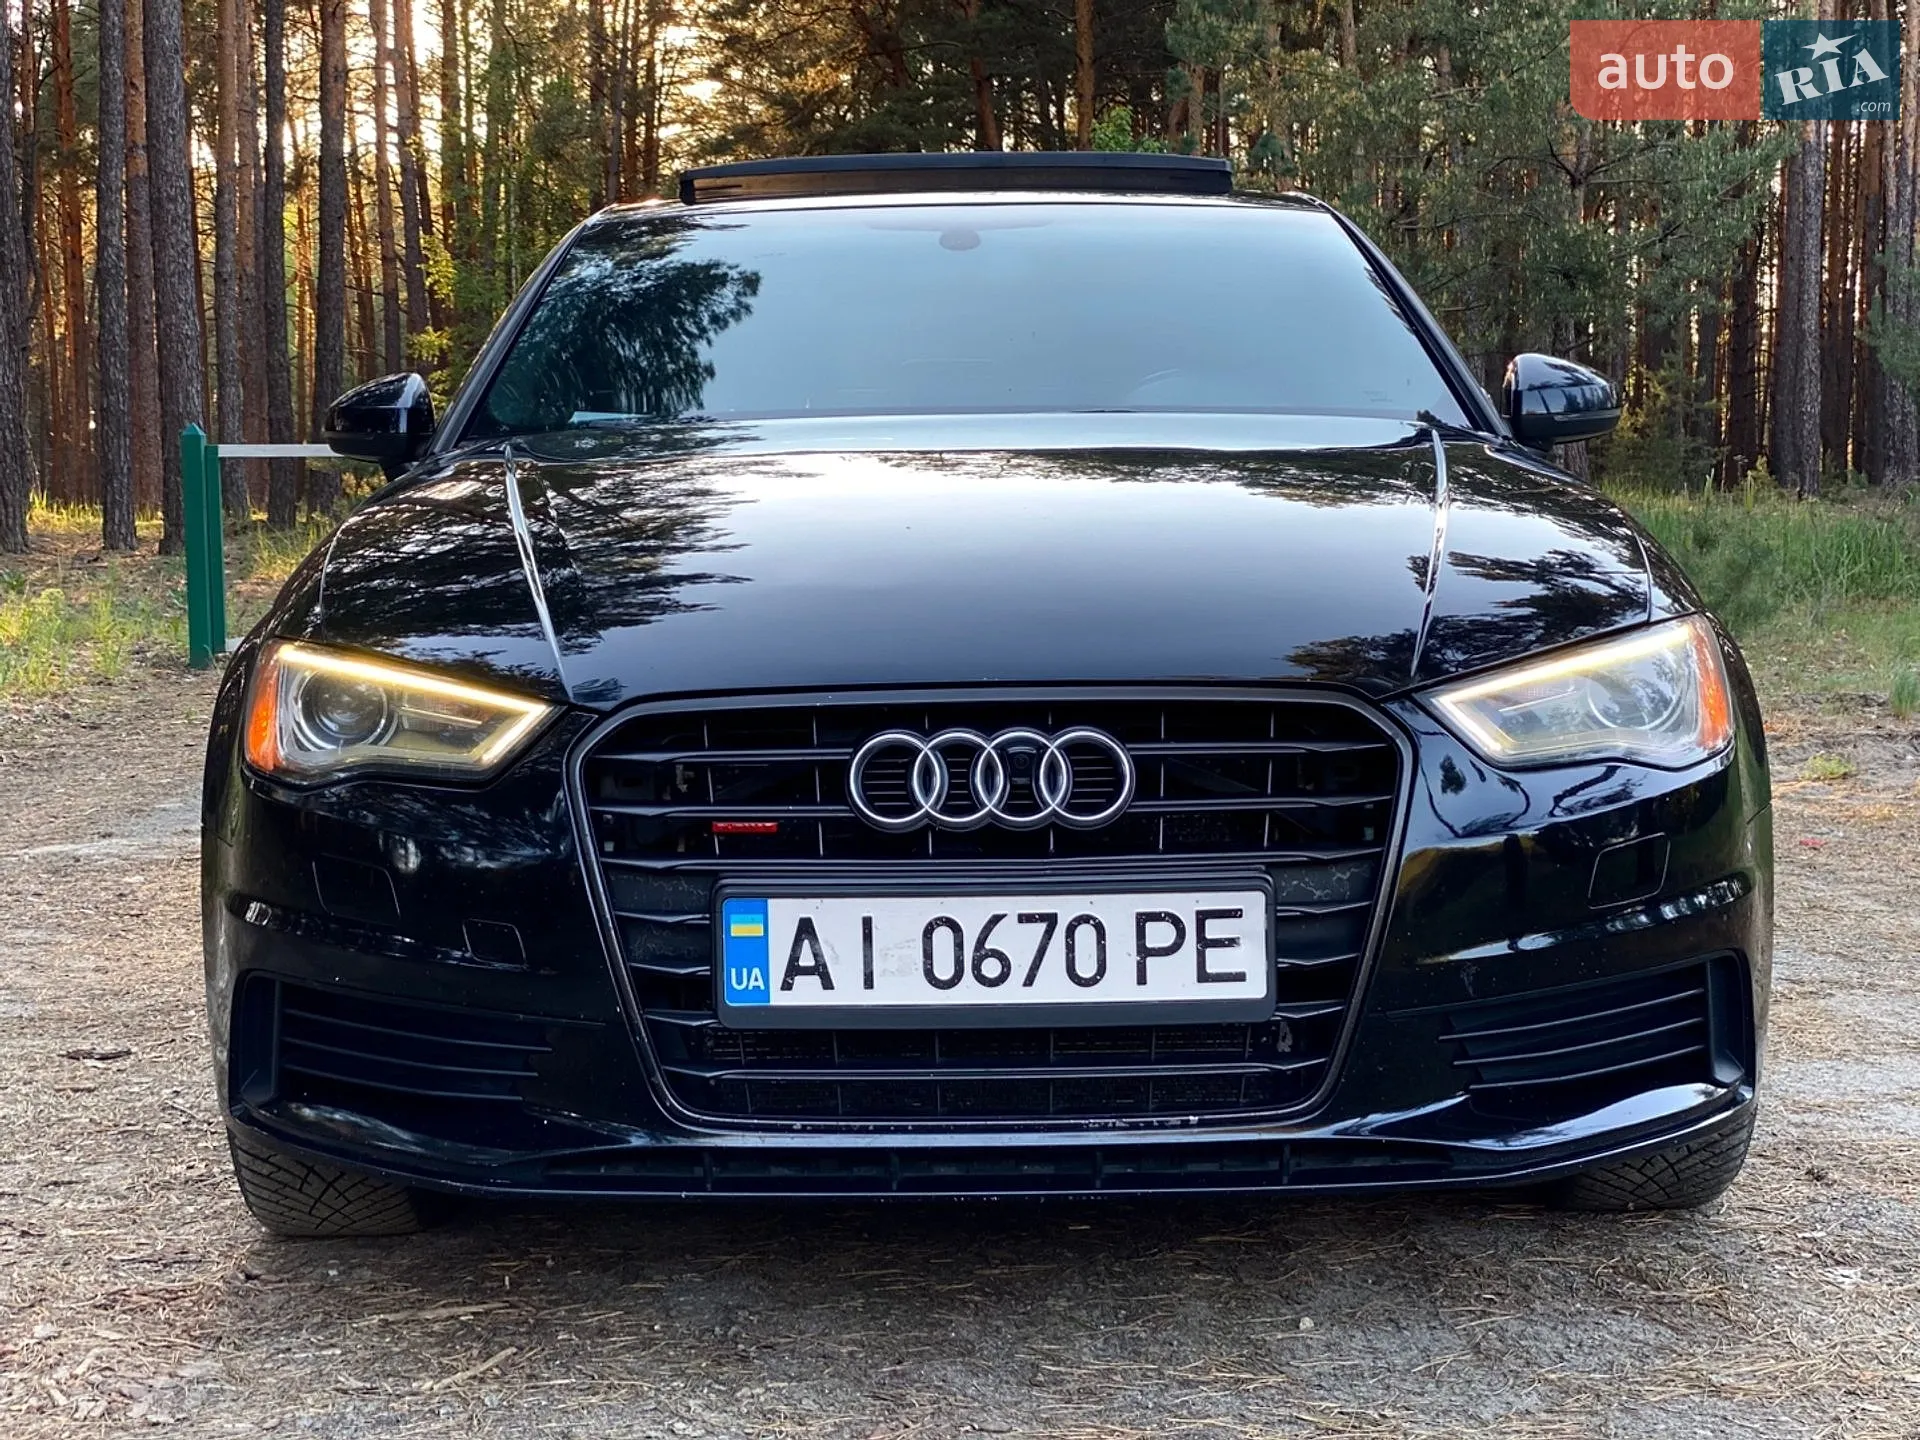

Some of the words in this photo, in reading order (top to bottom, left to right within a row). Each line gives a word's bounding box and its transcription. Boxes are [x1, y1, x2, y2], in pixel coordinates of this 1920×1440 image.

[780, 914, 875, 992] AI
[922, 912, 1107, 991] 0670
[1135, 907, 1248, 987] PE
[730, 967, 766, 991] UA
